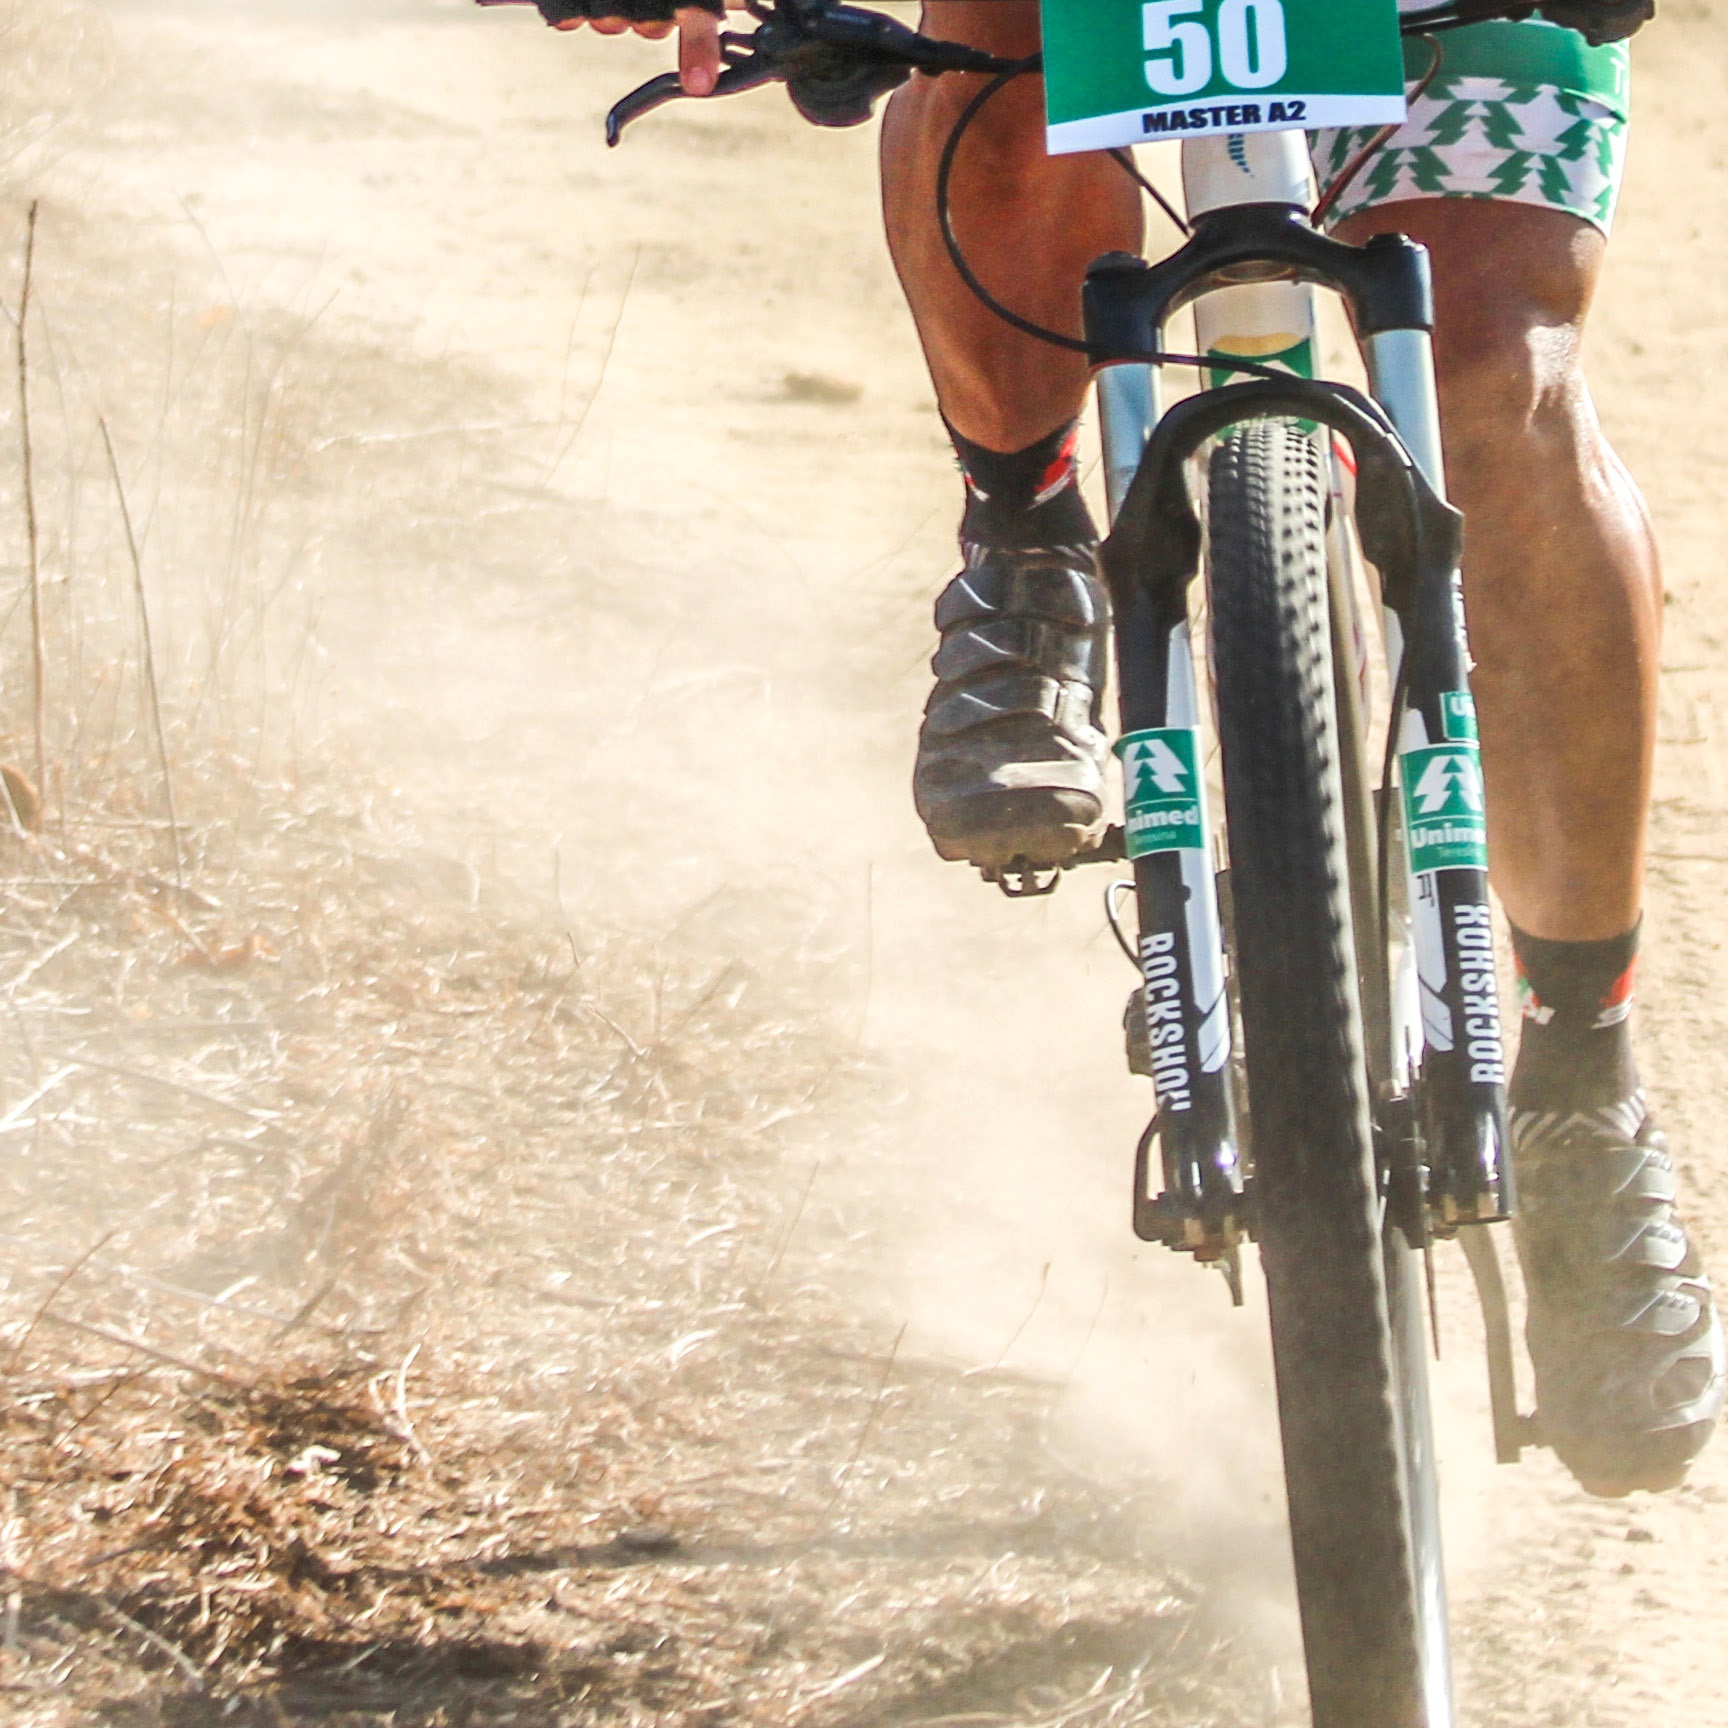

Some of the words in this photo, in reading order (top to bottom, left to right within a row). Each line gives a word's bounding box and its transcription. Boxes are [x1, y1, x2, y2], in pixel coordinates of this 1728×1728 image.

[1142, 104, 1261, 134] MASTER
[1267, 100, 1307, 123] A2
[1453, 903, 1505, 1085] ROCKSHOX
